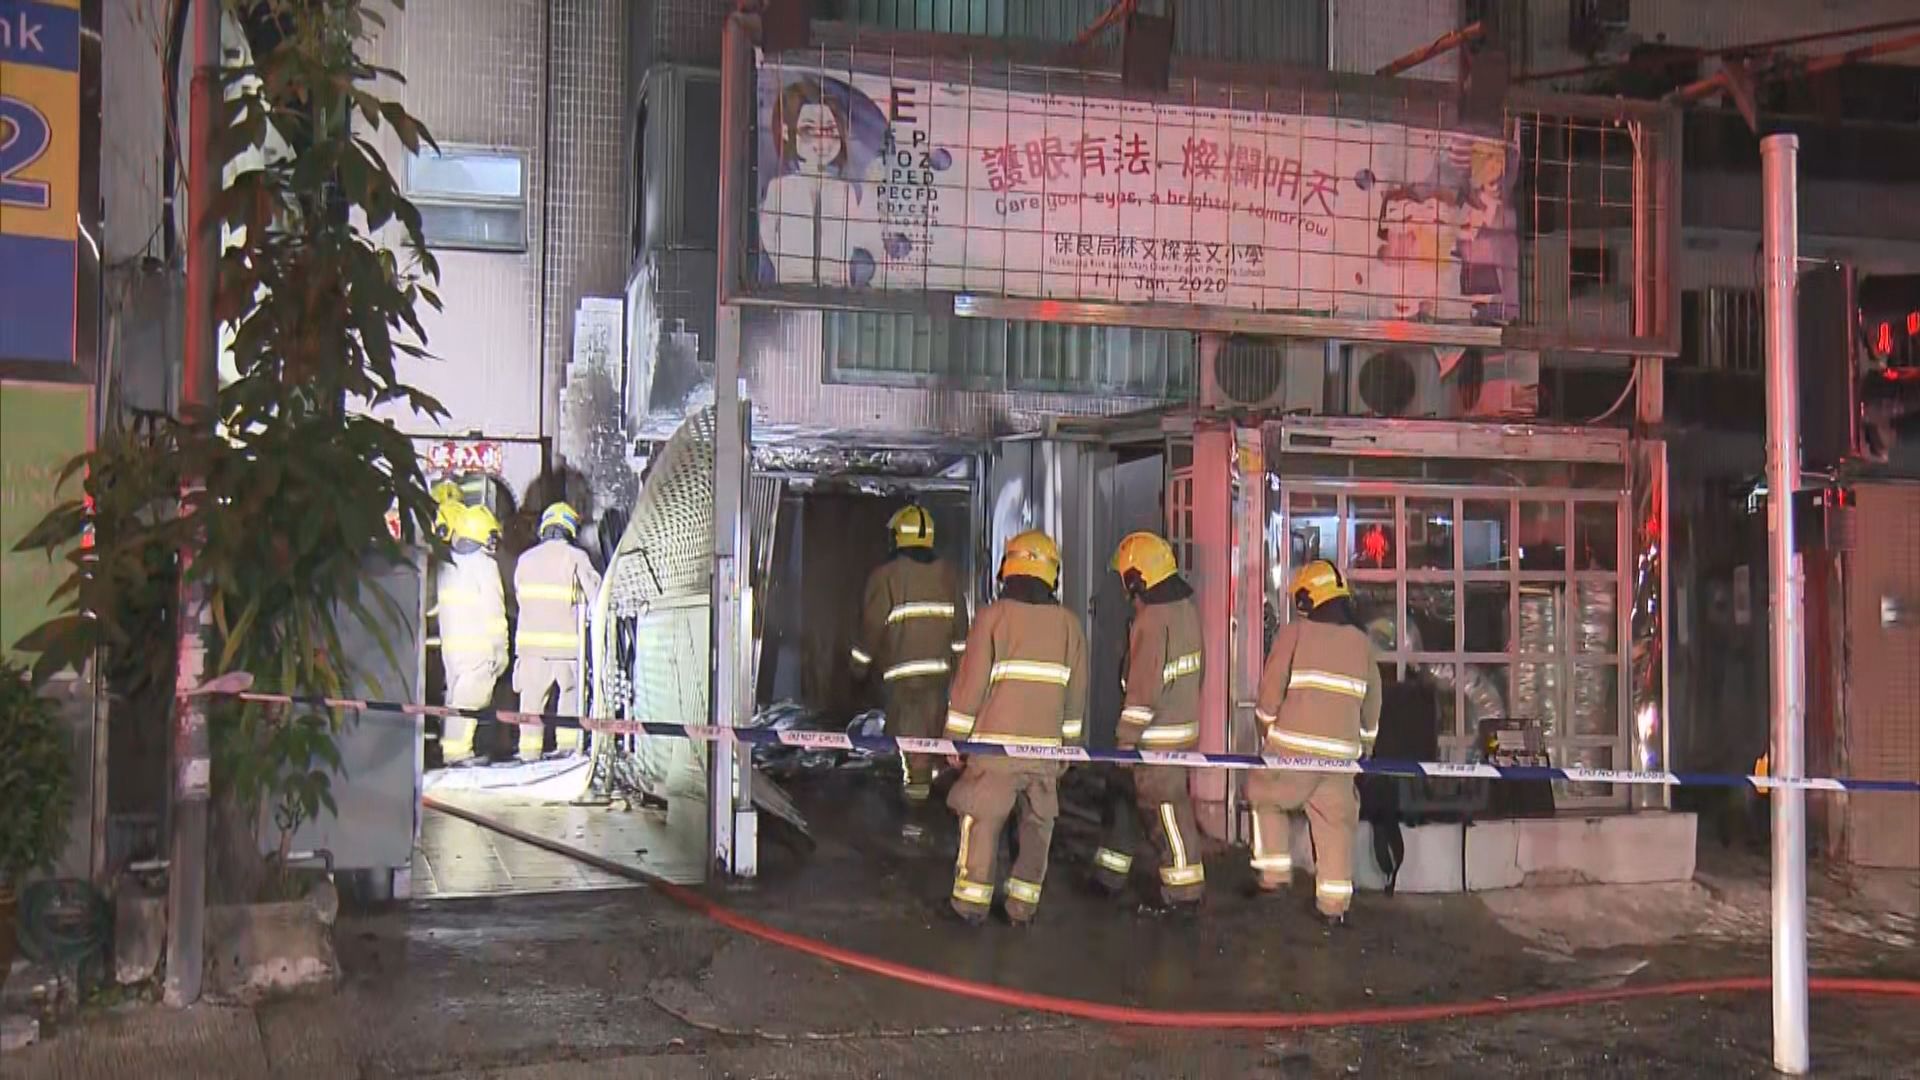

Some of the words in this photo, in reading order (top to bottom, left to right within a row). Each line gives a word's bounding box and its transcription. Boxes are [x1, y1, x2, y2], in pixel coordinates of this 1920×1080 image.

[891, 87, 917, 123] E
[1182, 136, 1340, 216] 燦爛明天
[995, 197, 1040, 215] Care
[1178, 275, 1226, 294] 2020
